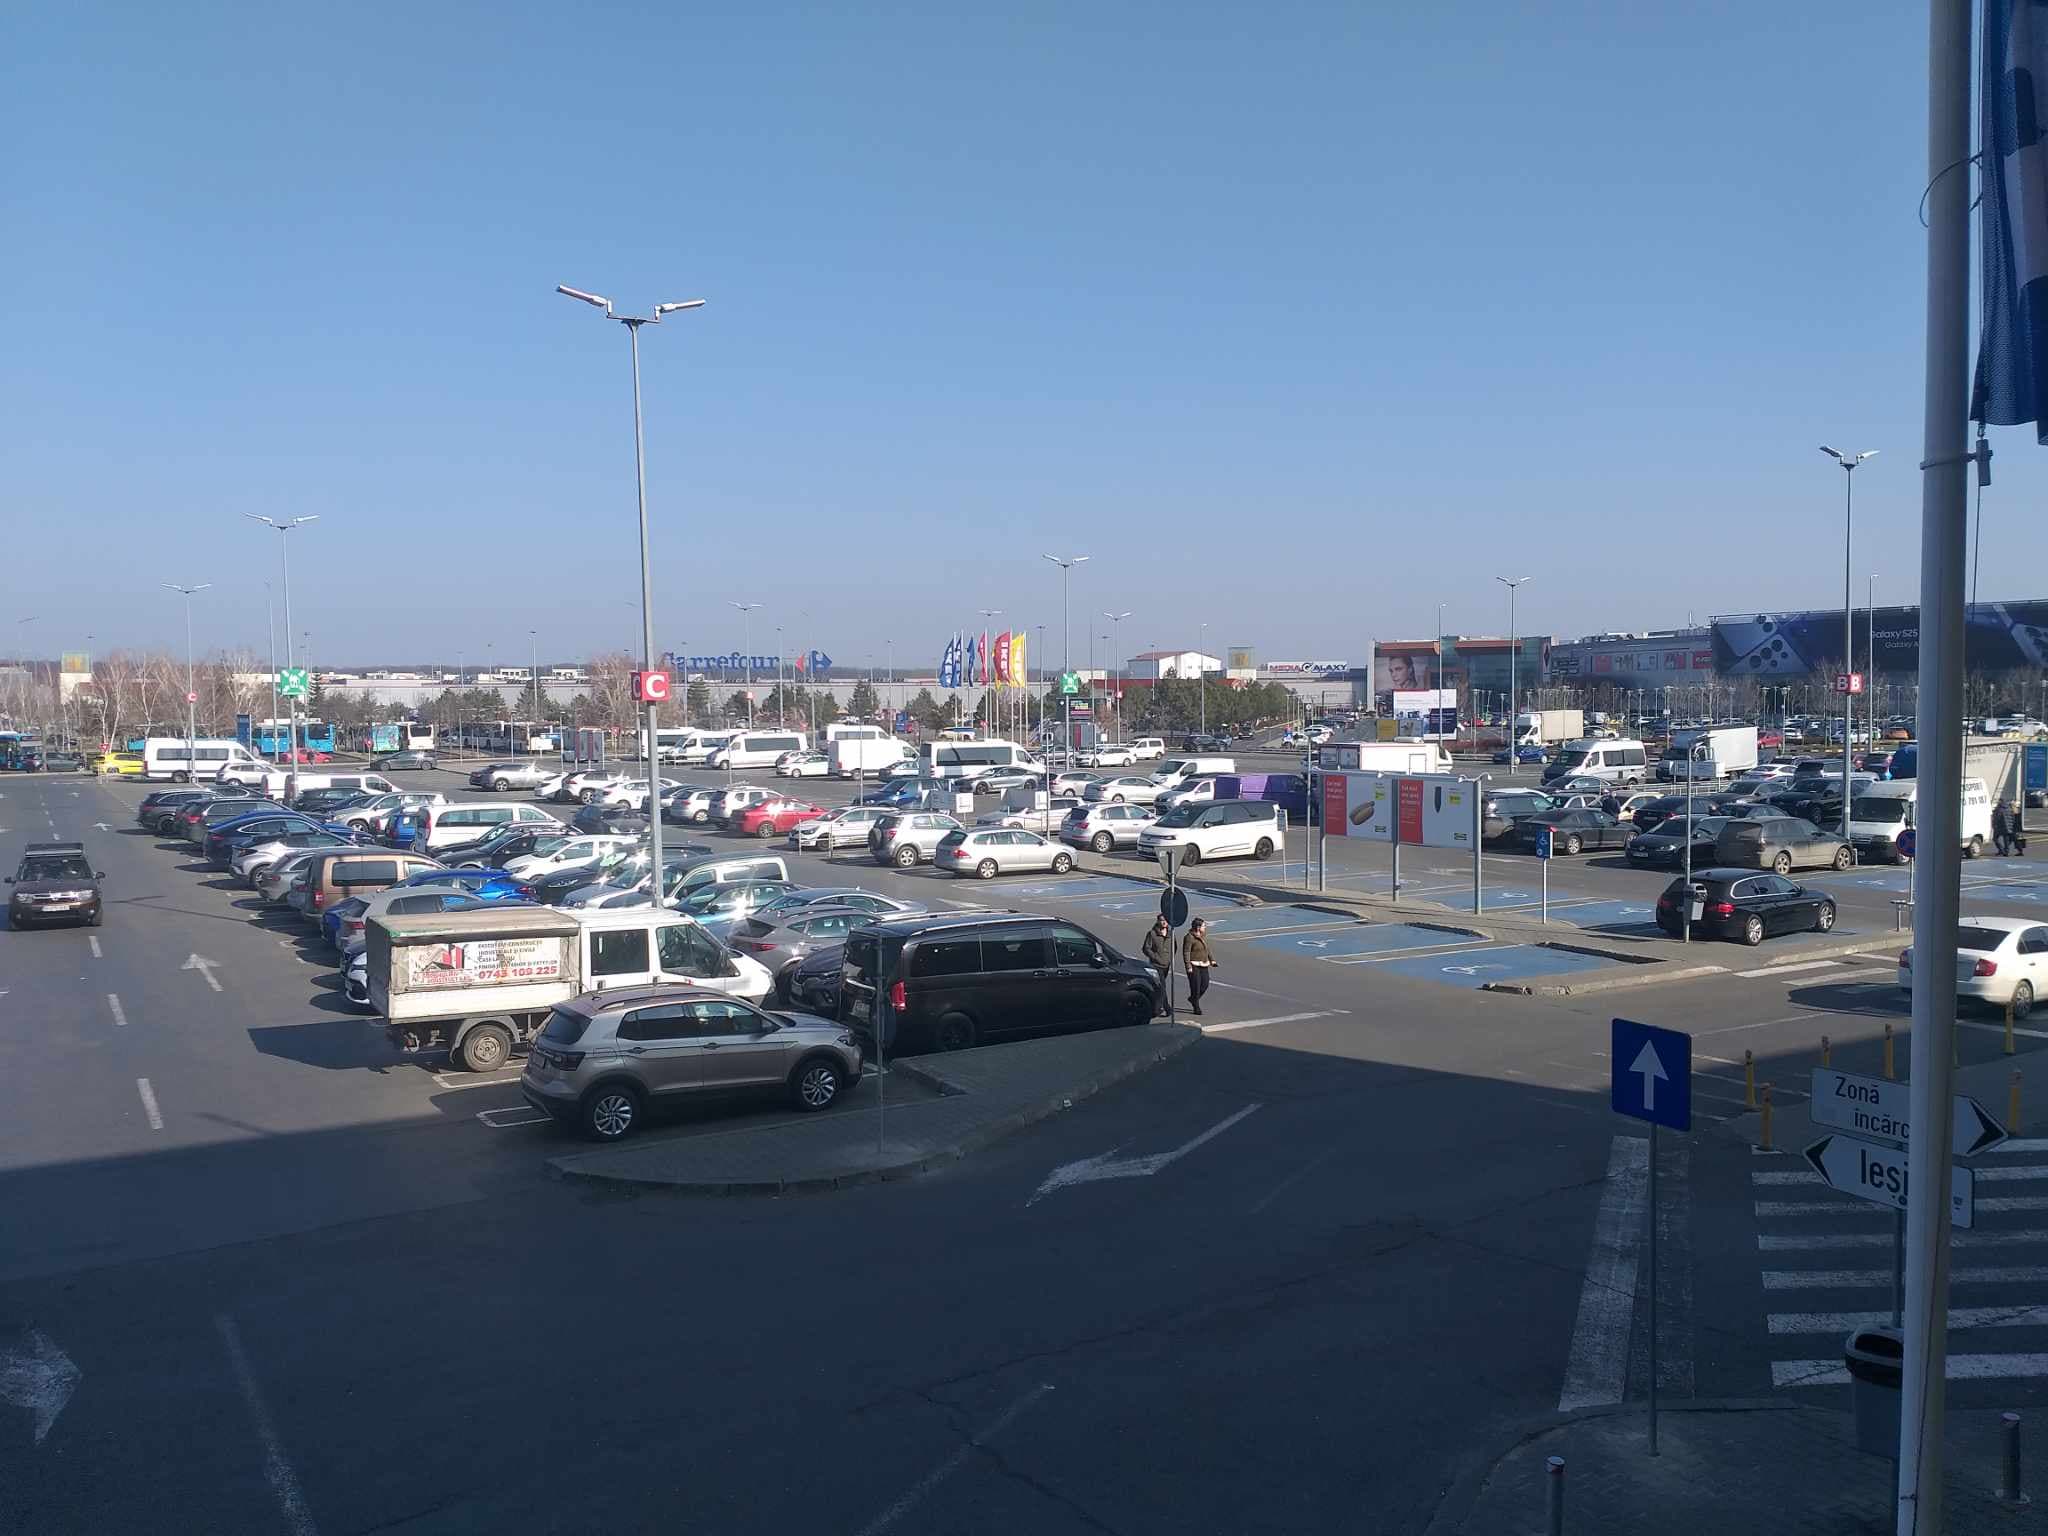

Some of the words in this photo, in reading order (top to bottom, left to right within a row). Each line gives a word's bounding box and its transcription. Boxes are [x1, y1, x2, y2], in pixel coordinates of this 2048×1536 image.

[646, 675, 666, 698] C
[1837, 676, 1847, 690] B
[1852, 676, 1860, 690] B
[536, 965, 558, 975] 225
[1835, 1075, 1880, 1105] Zonă
[1861, 1148, 1909, 1199] Ieși
